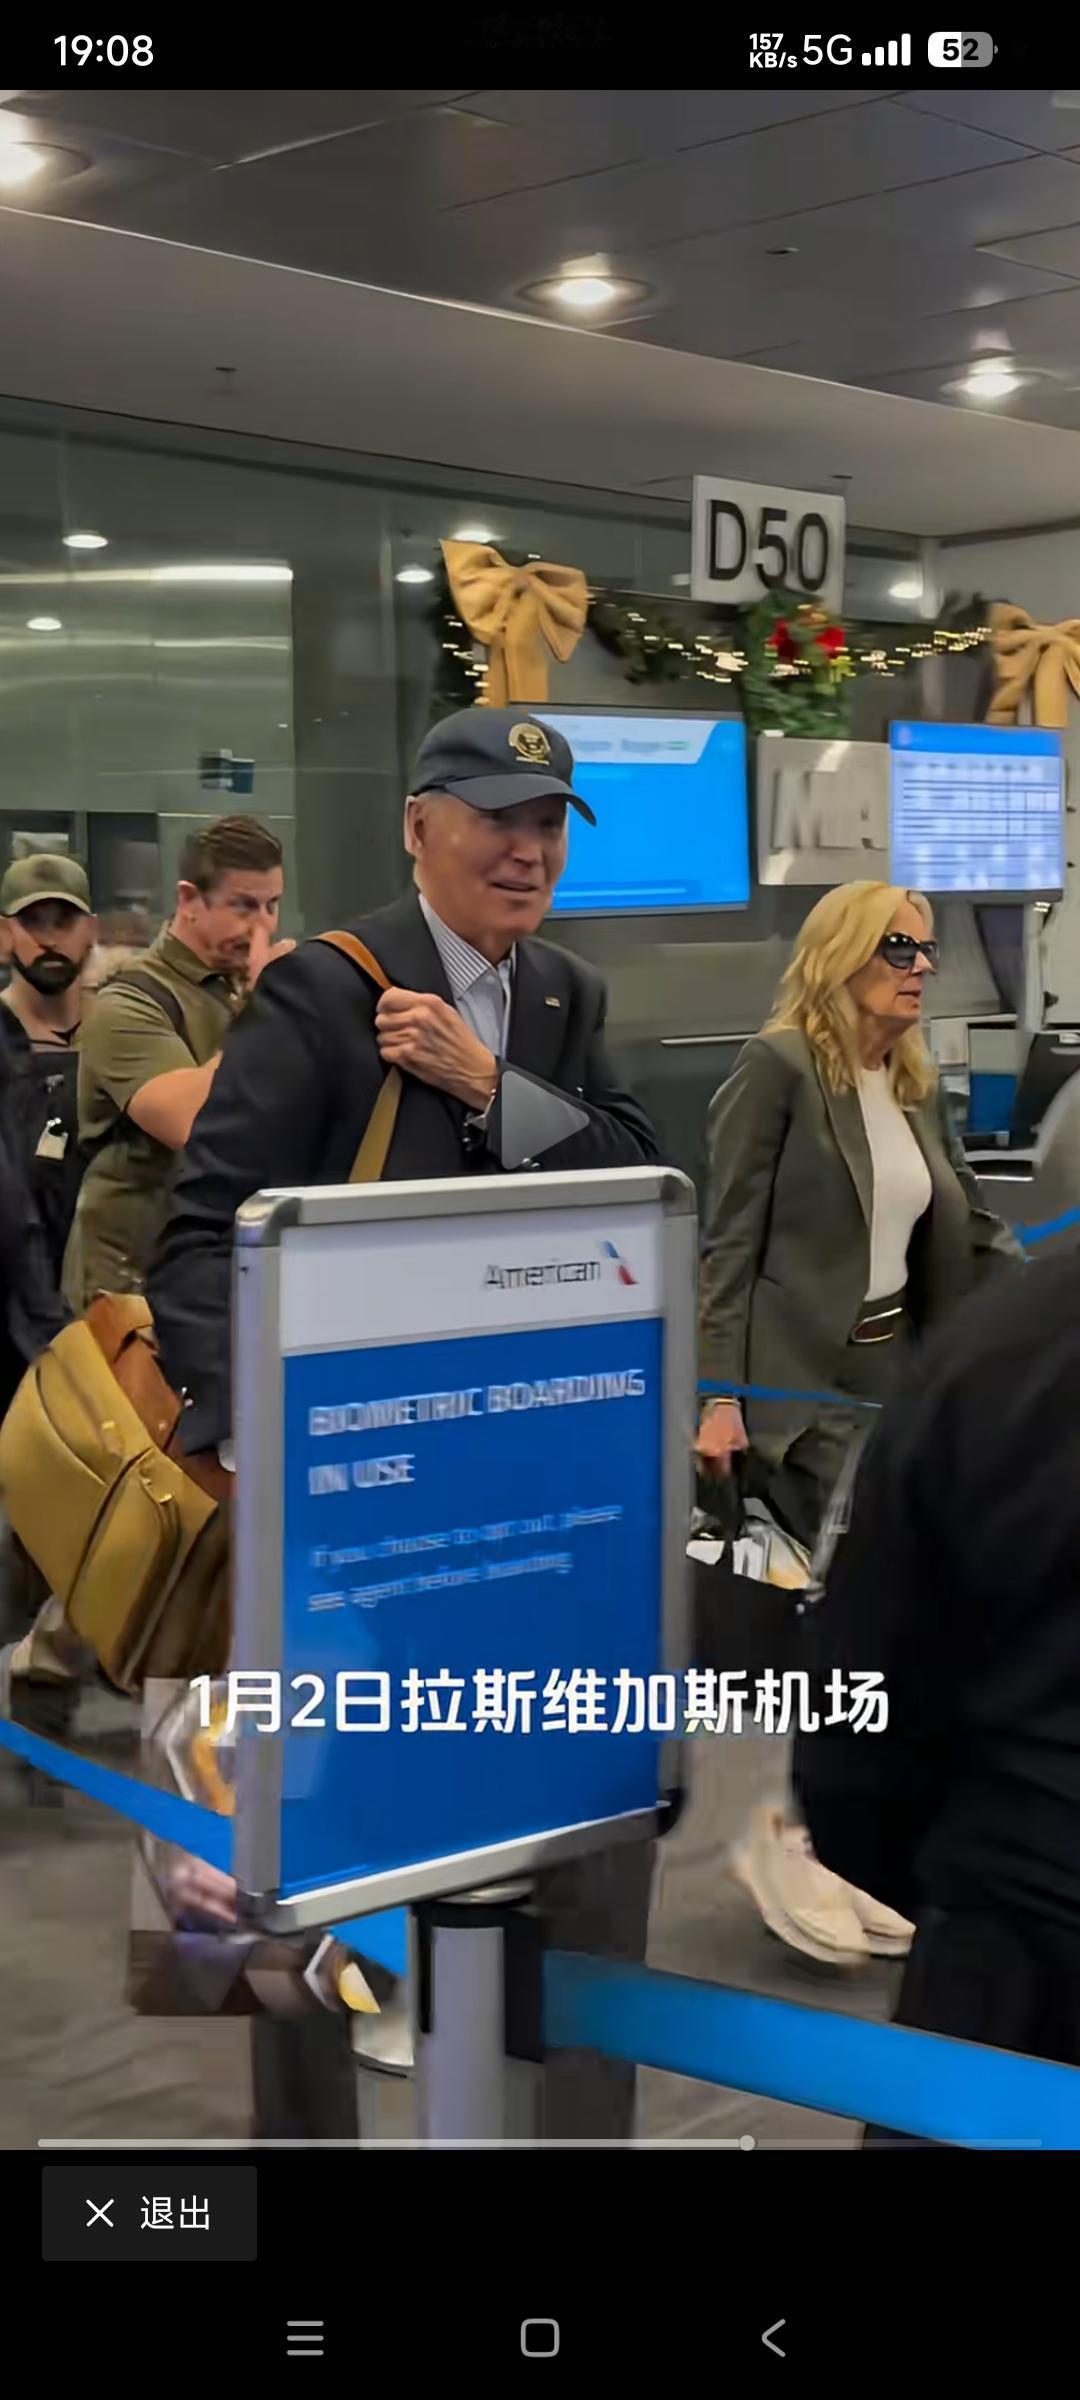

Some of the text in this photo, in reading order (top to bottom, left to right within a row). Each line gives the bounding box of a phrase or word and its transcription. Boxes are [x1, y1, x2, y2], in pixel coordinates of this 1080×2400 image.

[708, 499, 829, 592] D50
[484, 1257, 601, 1290] American
[308, 1369, 645, 1436] BIOMETRIC BOARDING
[308, 1453, 416, 1495] IN USE
